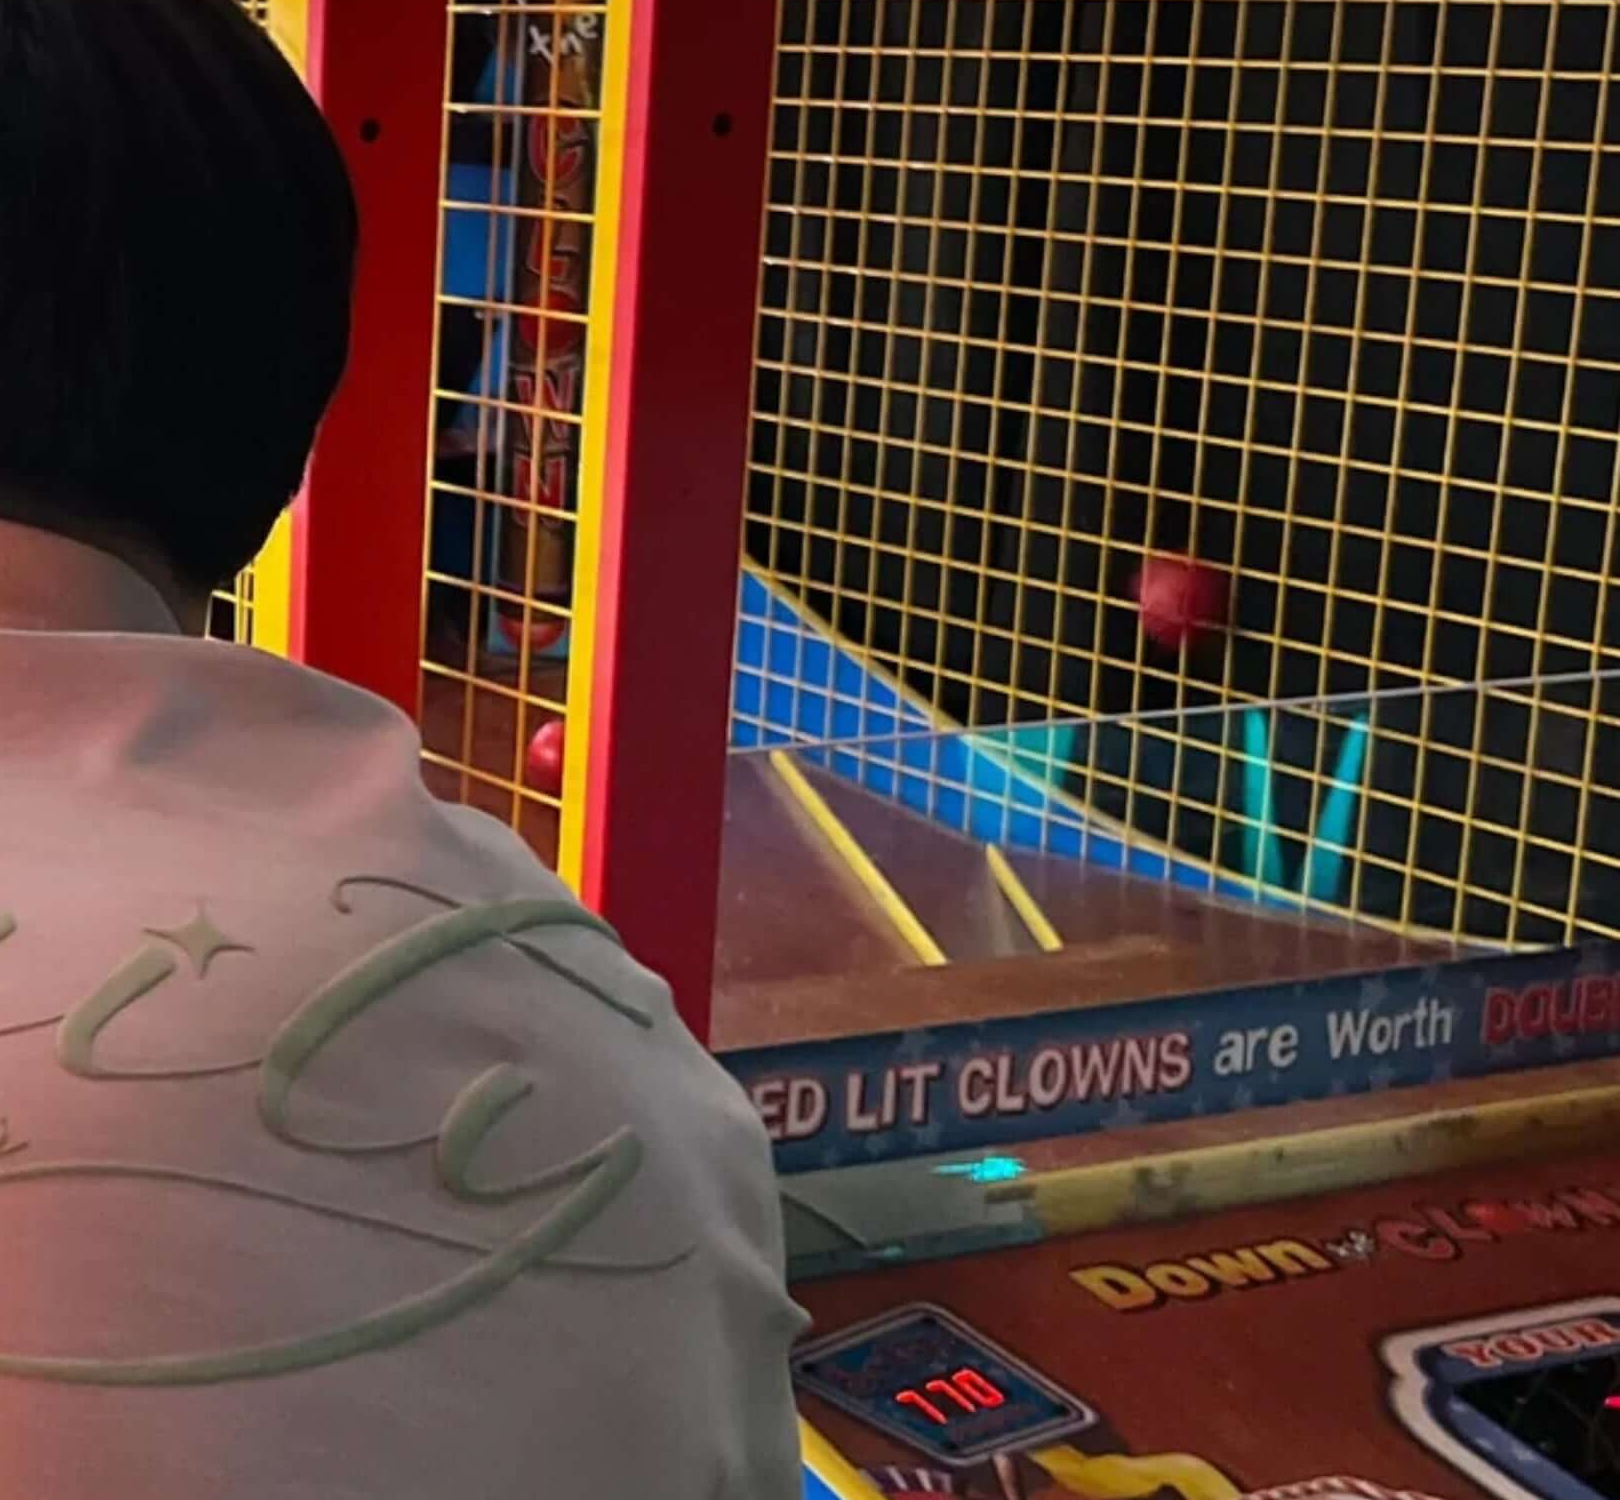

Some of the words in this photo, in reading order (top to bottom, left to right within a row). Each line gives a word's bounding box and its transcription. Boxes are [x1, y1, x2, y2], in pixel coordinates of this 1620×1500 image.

[845, 1062, 942, 1132] LIT
[957, 1032, 1192, 1117] CLOWNS
[1213, 1019, 1299, 1077] are
[1326, 998, 1454, 1060] Worth
[1482, 974, 1620, 1045] DOUB
[1440, 1318, 1620, 1368] YOUR
